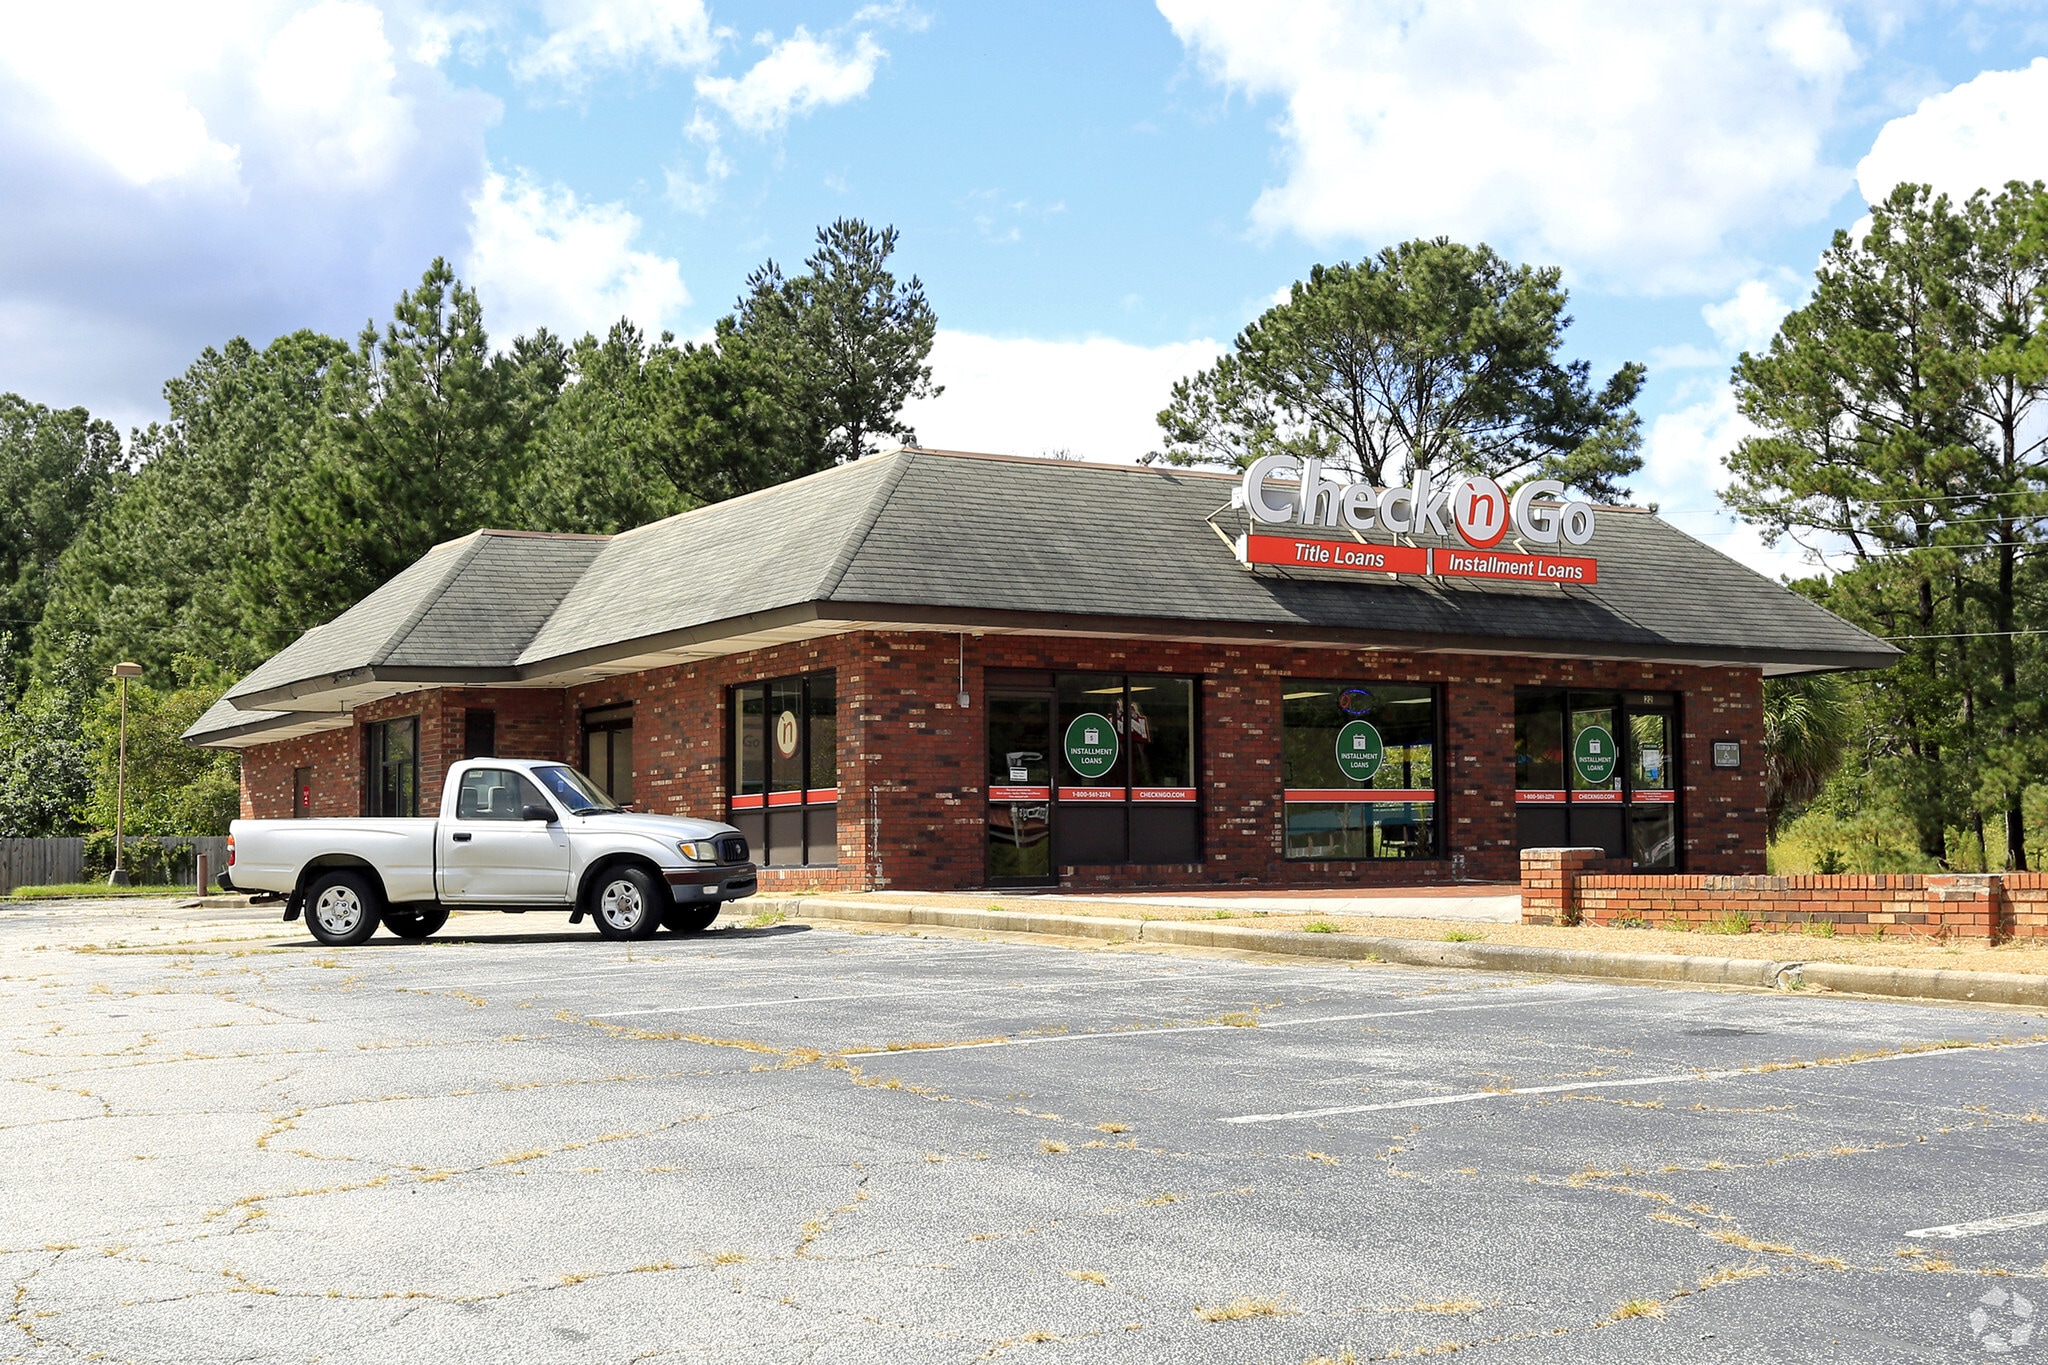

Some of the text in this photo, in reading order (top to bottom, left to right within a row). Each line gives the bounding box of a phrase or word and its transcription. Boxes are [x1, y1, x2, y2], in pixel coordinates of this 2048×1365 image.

[1242, 454, 1449, 536] Check
[1510, 480, 1596, 545] Go
[1294, 543, 1385, 567] Title Loans
[1449, 553, 1583, 579] Installment Loans
[743, 735, 760, 748] Go
[1070, 748, 1113, 756] INSTALLMENT
[1341, 752, 1378, 760] INSTALLMENT
[1081, 757, 1103, 765] LOANS
[1139, 791, 1186, 799] CHECKNGO.COM
